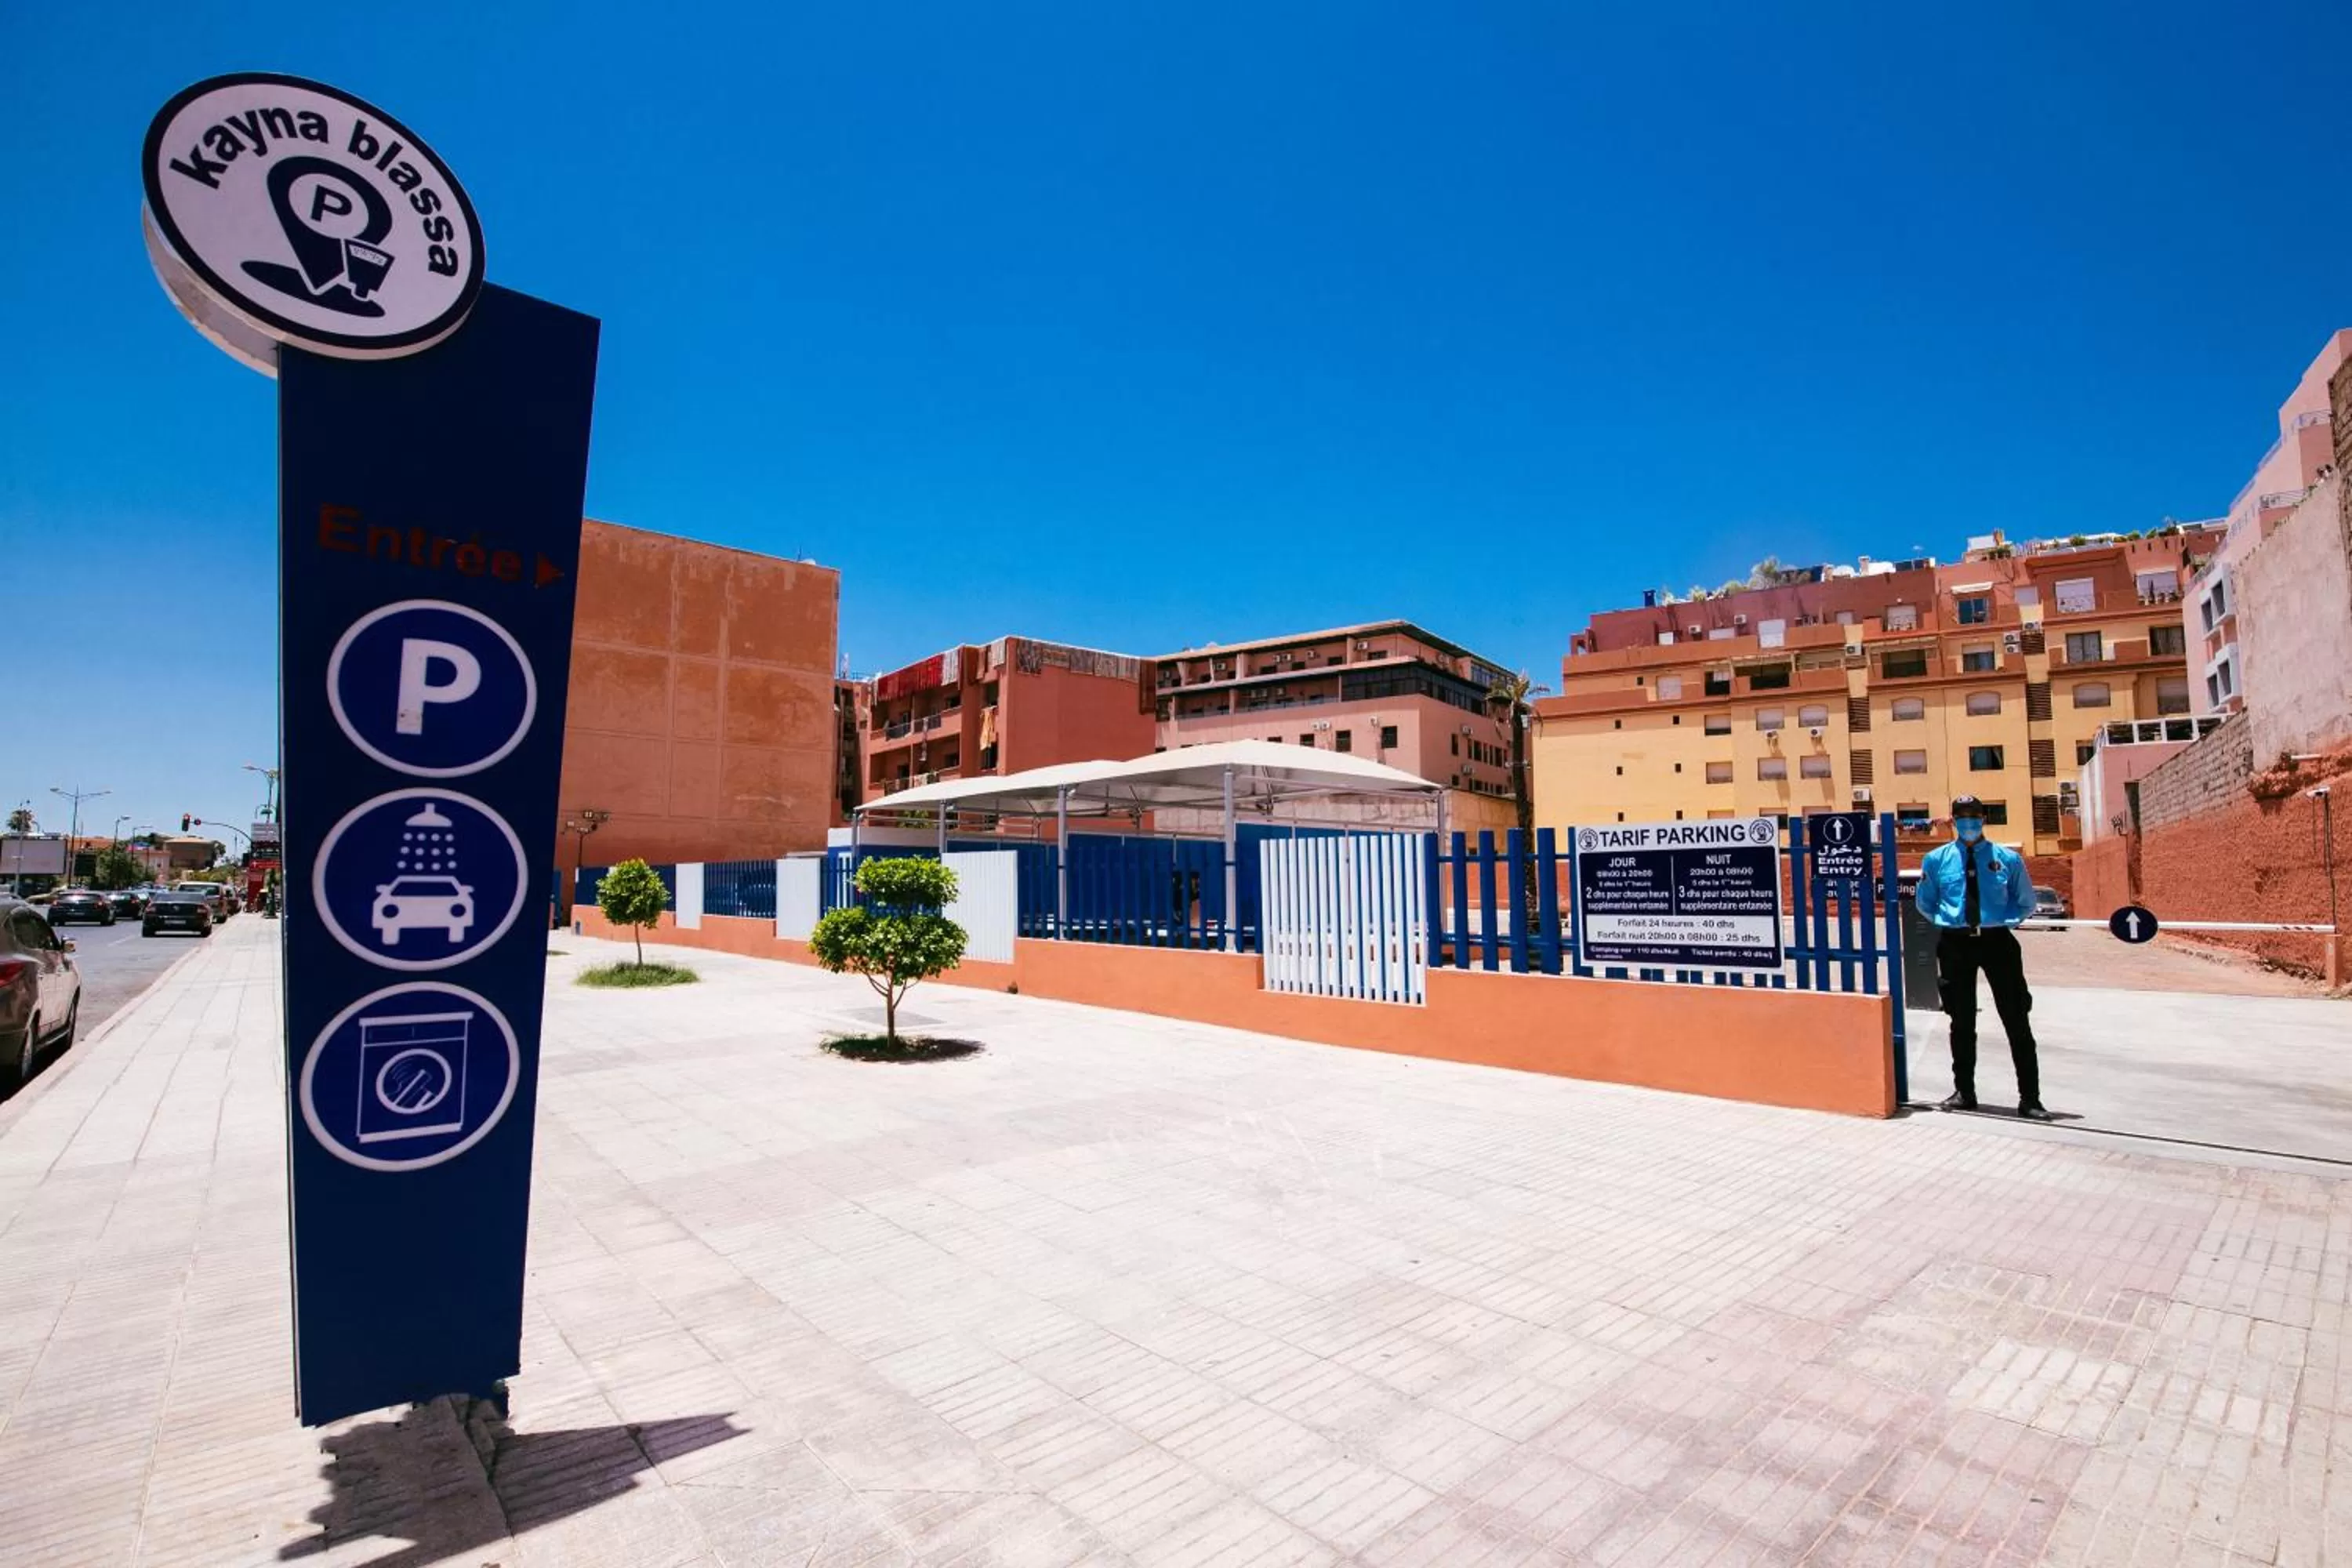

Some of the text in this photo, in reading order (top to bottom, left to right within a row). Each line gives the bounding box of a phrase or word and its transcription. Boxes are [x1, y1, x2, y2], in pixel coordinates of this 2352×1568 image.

[169, 107, 459, 278] kayna blassa
[310, 184, 352, 222] P
[396, 637, 481, 735] P
[1599, 829, 1650, 847] TARIF
[1657, 824, 1745, 844] PARKING
[1817, 844, 1862, 856] دخول
[1608, 857, 1636, 867] JOUR
[1706, 854, 1732, 865] NUIT
[1818, 855, 1864, 865] Entrée
[1726, 866, 1754, 876] 08h00
[1818, 866, 1863, 876] Entry
[1585, 887, 1669, 900] 2 dhs pour chaque heure
[1679, 885, 1773, 900] 3 dhs pour chaque heure
[1617, 918, 1646, 927] Forfait
[1649, 918, 1660, 927] 24
[1661, 918, 1694, 927] heures
[1628, 931, 1646, 940] nuit
[1687, 932, 1718, 942] 08h00
[1741, 934, 1761, 942] dhs
